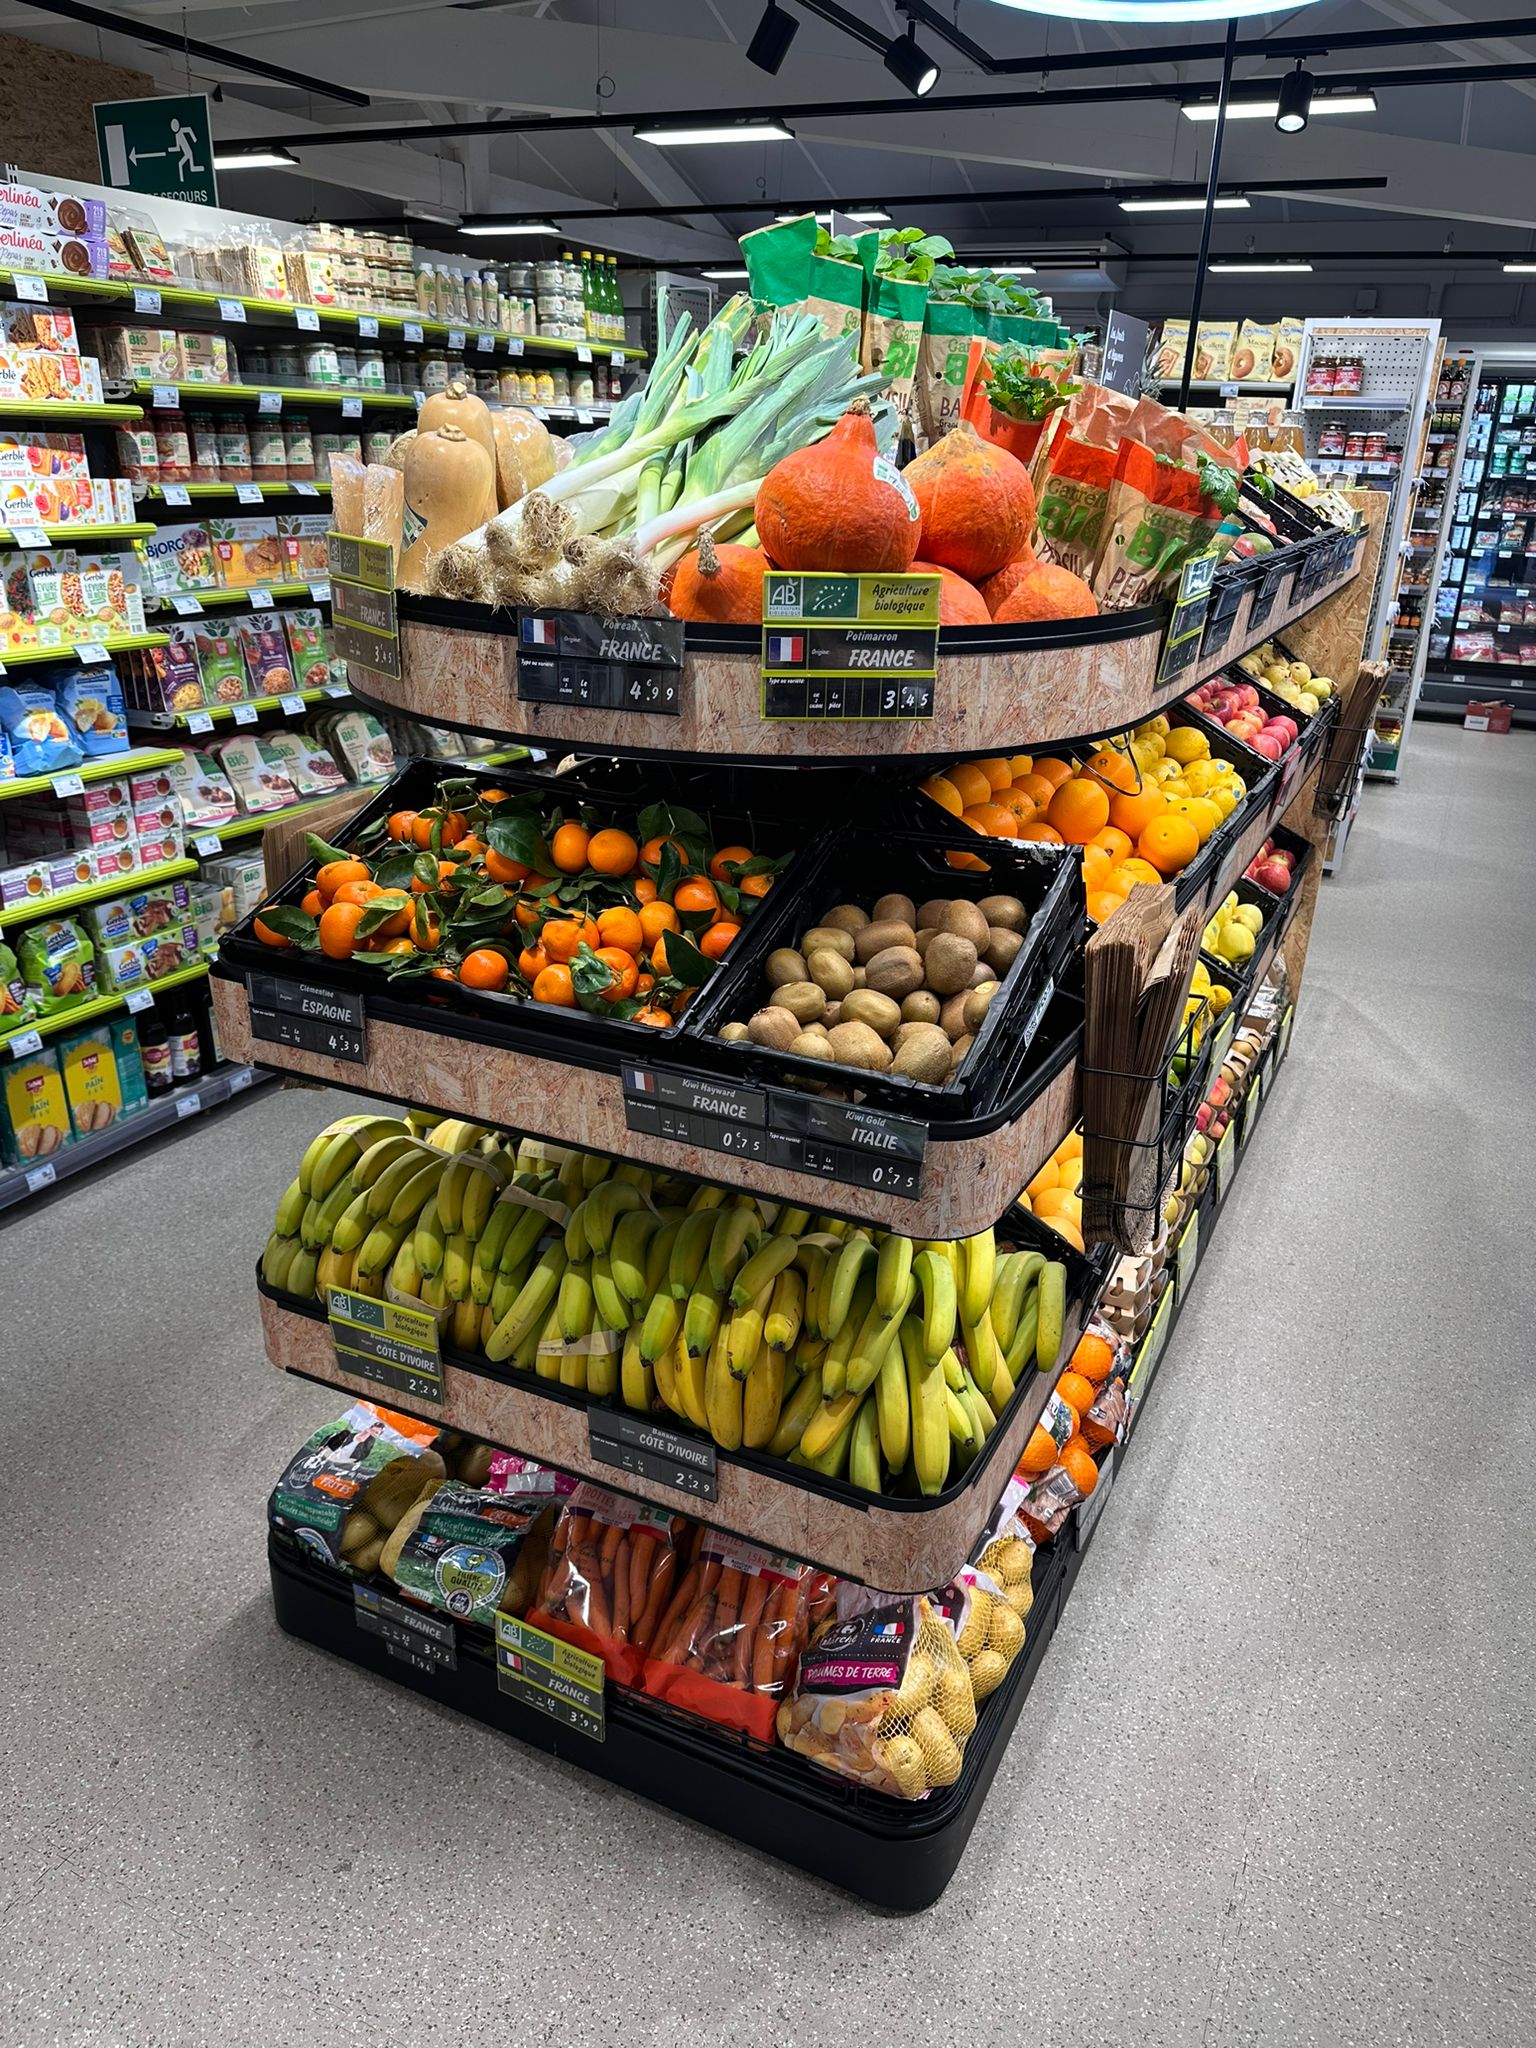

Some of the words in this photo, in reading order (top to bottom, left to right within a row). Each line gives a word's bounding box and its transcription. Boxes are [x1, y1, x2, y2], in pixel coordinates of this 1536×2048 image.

[128, 334, 148, 346] BIO
[183, 338, 201, 350] BIO
[5, 499, 33, 510] Gerblé
[29, 567, 57, 578] Gerblé
[771, 584, 796, 605] AB
[872, 583, 930, 598] Agriculture
[874, 599, 926, 614] biologique
[360, 605, 386, 627] FRANCE
[845, 630, 898, 642] Potimarron
[598, 638, 663, 661] FRANCE
[848, 649, 916, 668] FRANCE
[341, 730, 359, 742] BIO
[225, 754, 248, 767] BIO
[243, 870, 260, 883] BIO
[194, 902, 214, 916] BIO
[299, 983, 334, 999] Clémentine
[302, 999, 352, 1023] ESPAGNE
[682, 1079, 700, 1089] Kiwi
[701, 1083, 736, 1098] Hayward
[692, 1095, 747, 1119] FRANCE
[845, 1110, 864, 1123] Kiwi
[866, 1115, 887, 1128] Gold
[851, 1127, 899, 1150] ITALIE
[392, 1311, 430, 1329] Agriculture
[394, 1321, 428, 1338] biologique
[376, 1343, 398, 1359] CÔTE
[400, 1352, 436, 1373] D'IVOIRE
[651, 1427, 678, 1443] Banane
[639, 1433, 665, 1450] CÔTE
[667, 1442, 709, 1466] D'IVOIRE
[319, 1477, 354, 1495] FRITES
[434, 1518, 475, 1533] Agriculture
[450, 1576, 483, 1591] QUALITÉ
[457, 1571, 482, 1583] FILIÈRE
[404, 1615, 442, 1640] FRANCE
[502, 1623, 518, 1638] AB
[561, 1649, 599, 1671] Agriculture
[563, 1658, 596, 1679] biologique
[807, 1665, 844, 1680] POMMES
[845, 1666, 860, 1678] DE
[862, 1667, 893, 1679] TERRE
[548, 1679, 591, 1706] FRANCE
